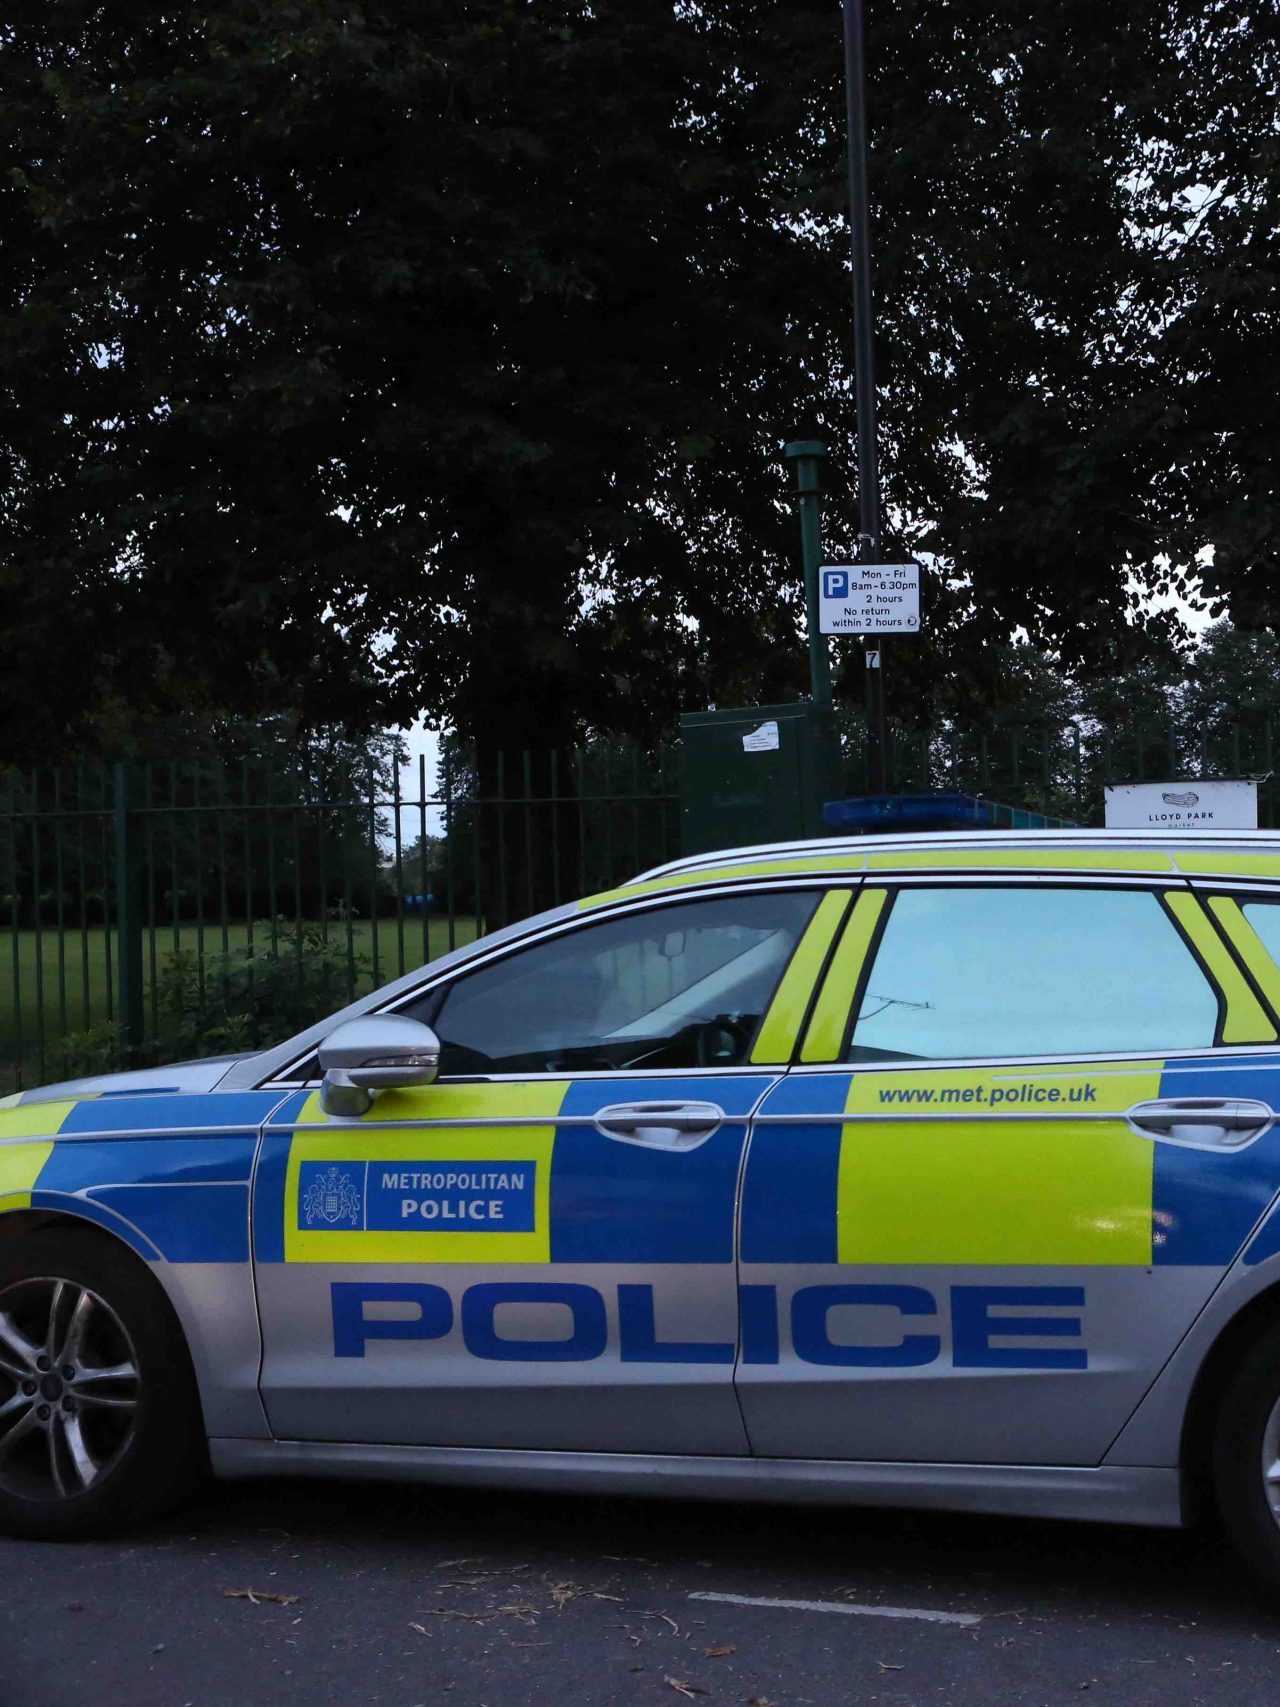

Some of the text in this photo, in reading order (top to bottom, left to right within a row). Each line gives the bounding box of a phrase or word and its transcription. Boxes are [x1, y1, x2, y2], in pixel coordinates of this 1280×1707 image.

[862, 571, 882, 579] Mon
[894, 570, 906, 578] Fri
[866, 595, 903, 603] 2 hours
[844, 608, 857, 616] No
[832, 618, 902, 627] within 2 hours
[1149, 812, 1215, 821] LLOYD PARK
[879, 1083, 1097, 1107] www.met.police.uk
[382, 1173, 524, 1190] METROPOLITAN
[401, 1199, 504, 1220] POLICE
[330, 1281, 1088, 1369] POLICE
